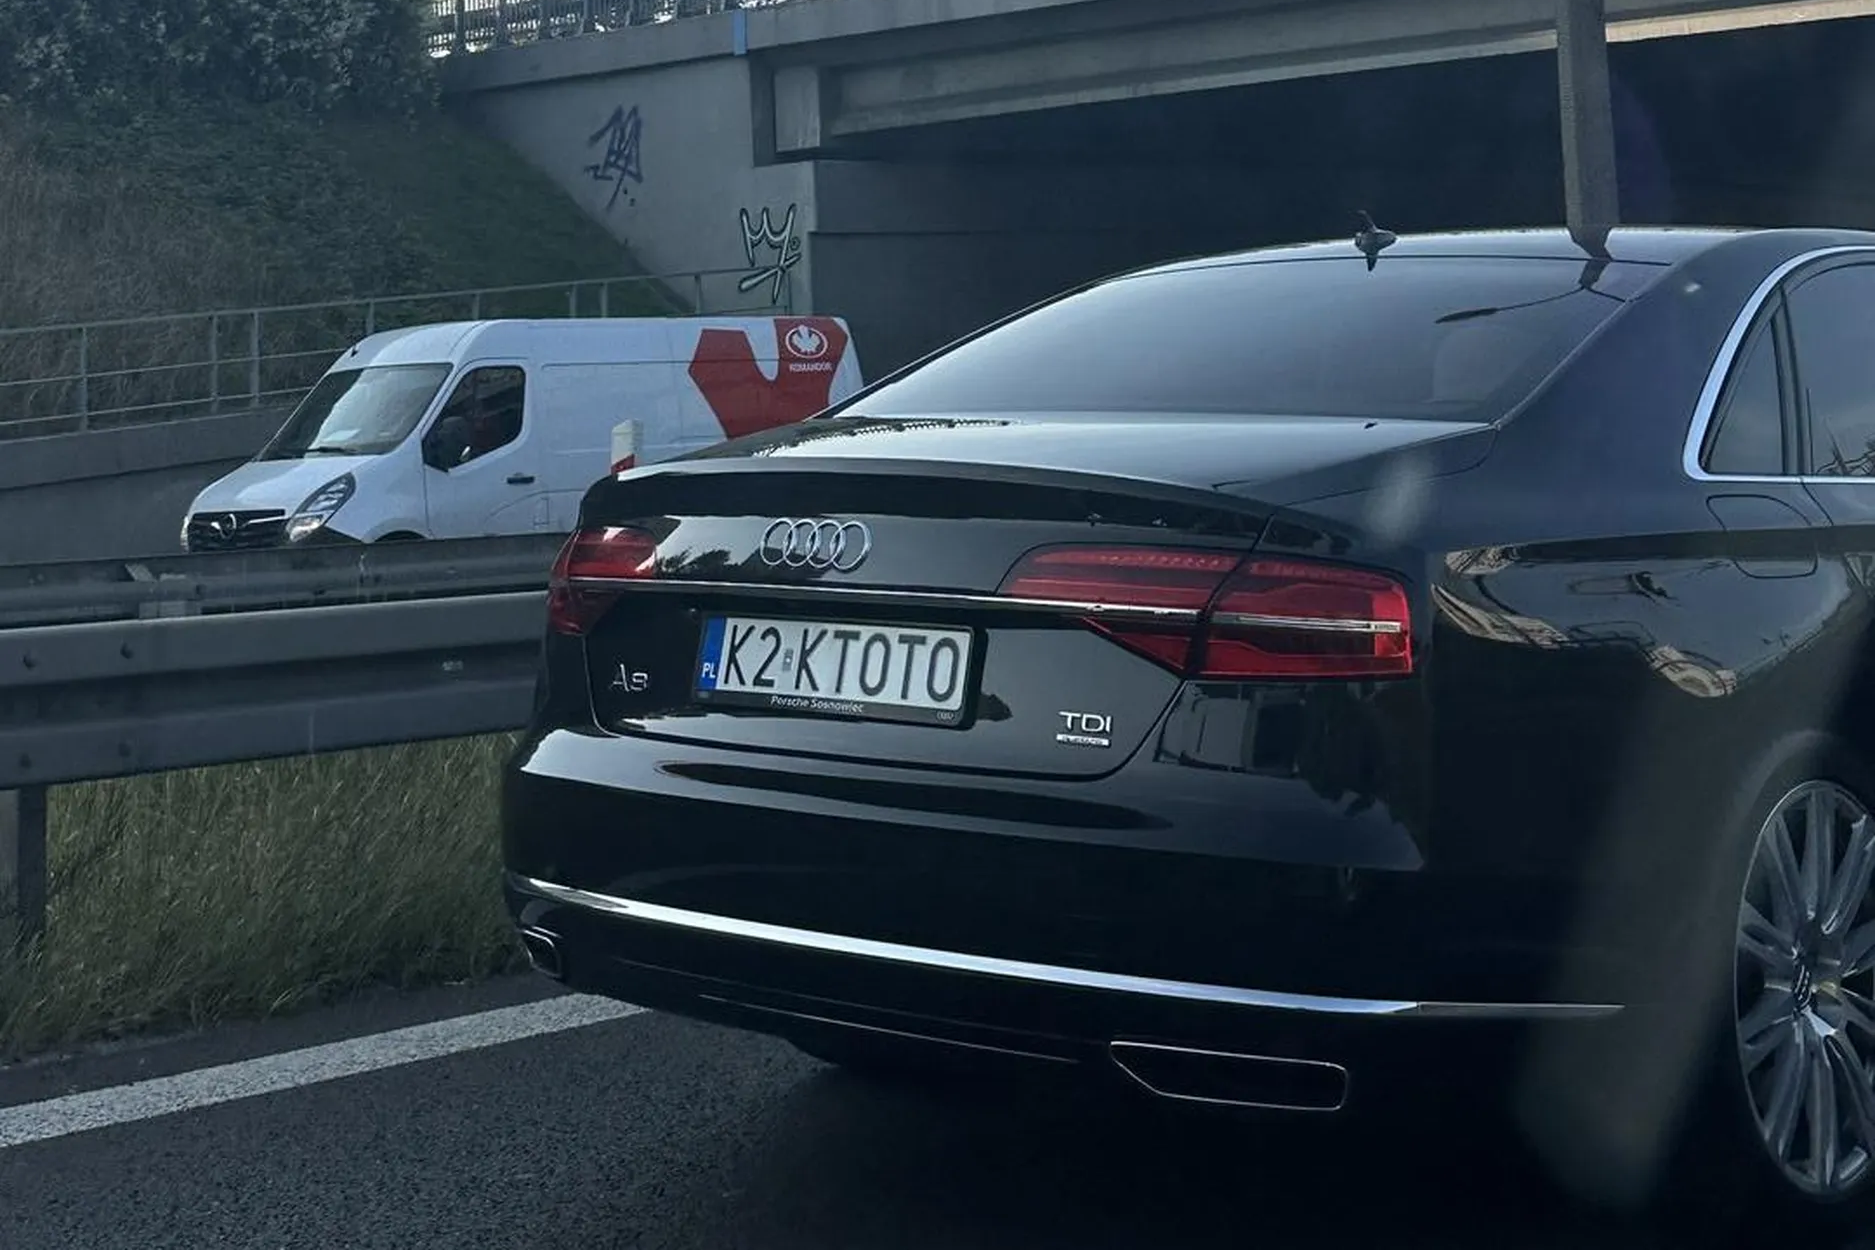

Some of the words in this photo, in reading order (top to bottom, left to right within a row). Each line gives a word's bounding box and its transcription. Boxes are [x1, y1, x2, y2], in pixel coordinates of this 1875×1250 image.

[701, 661, 717, 678] PL
[723, 624, 783, 688] K2
[794, 628, 961, 703] KTOTO
[609, 662, 649, 692] A8
[1058, 710, 1112, 733] TDI
